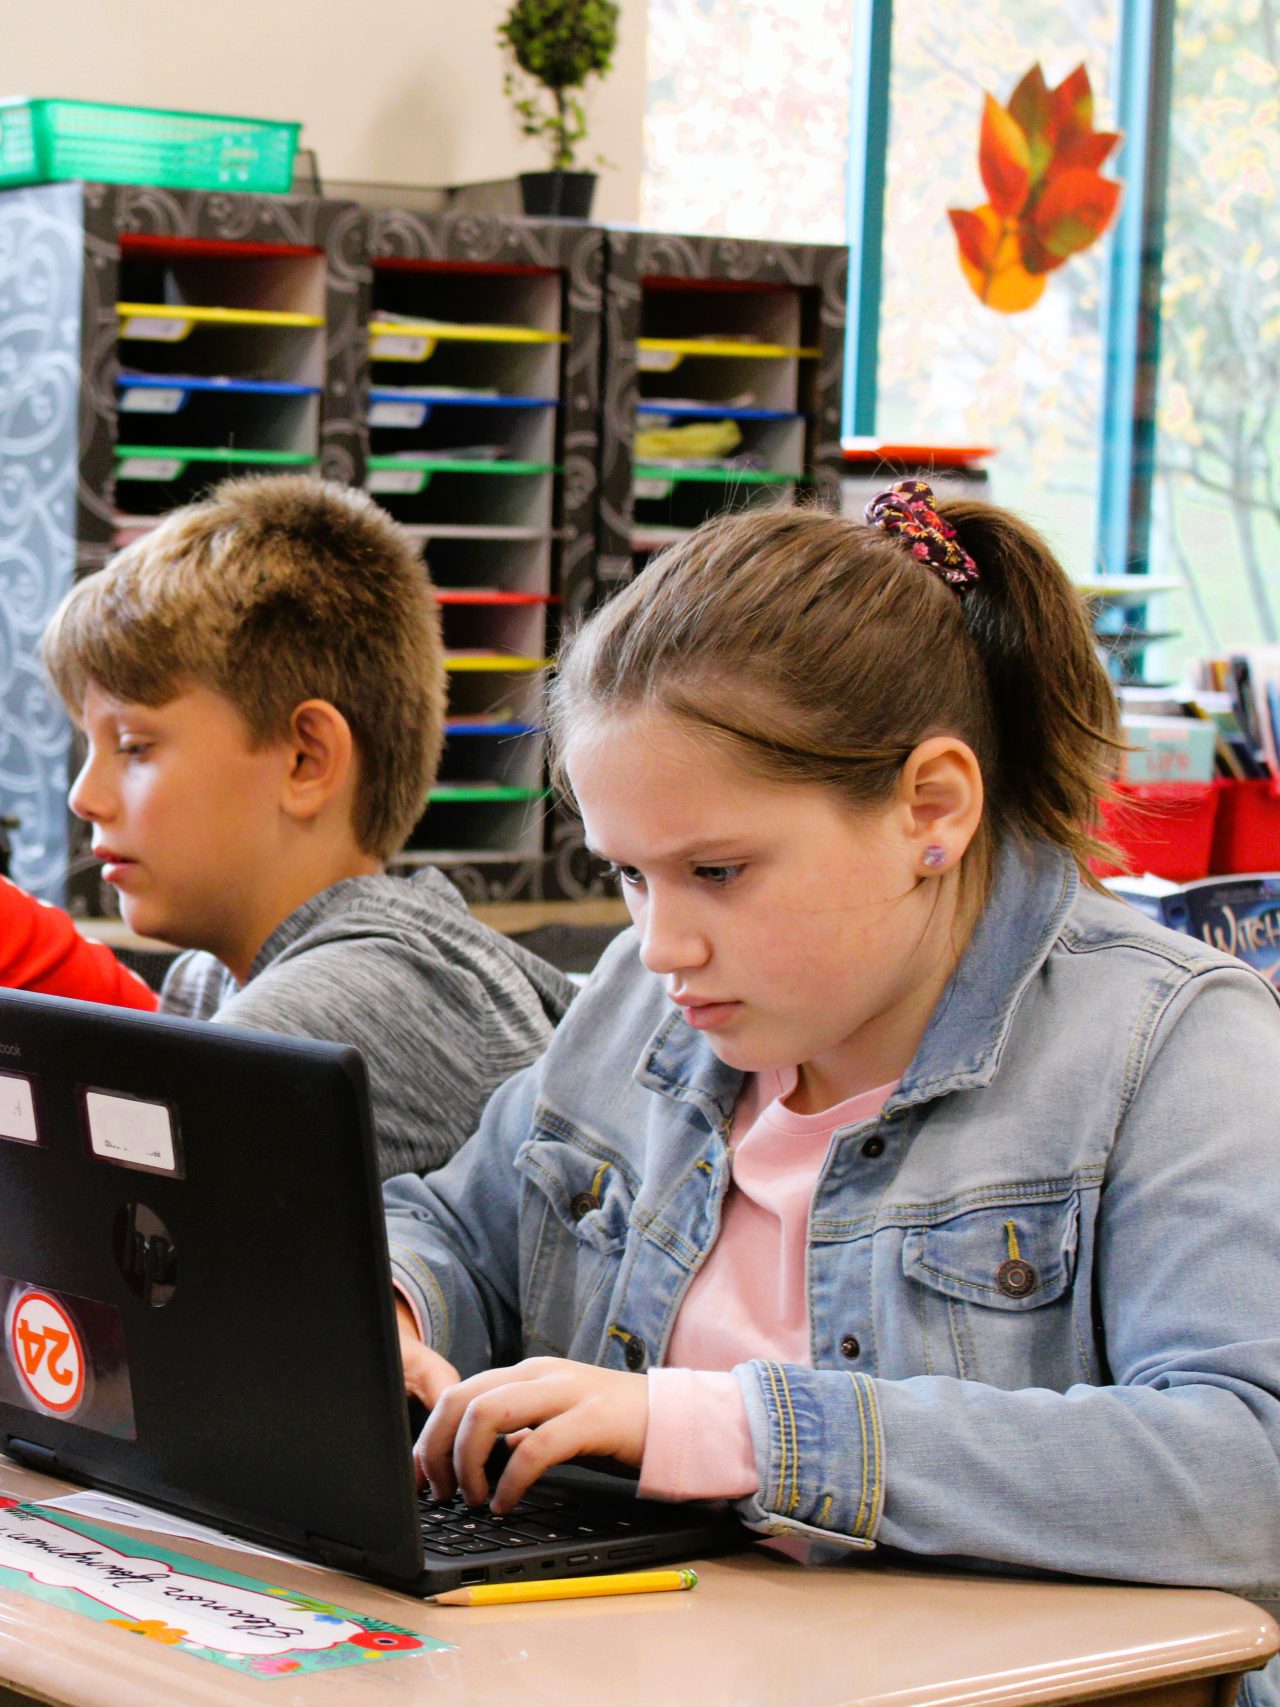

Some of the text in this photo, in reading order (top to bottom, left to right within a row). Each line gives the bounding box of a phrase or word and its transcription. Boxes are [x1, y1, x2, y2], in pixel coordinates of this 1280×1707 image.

[17, 1318, 74, 1387] 24
[6, 1532, 171, 1588] Youngman
[163, 1586, 304, 1639] Eleanor
